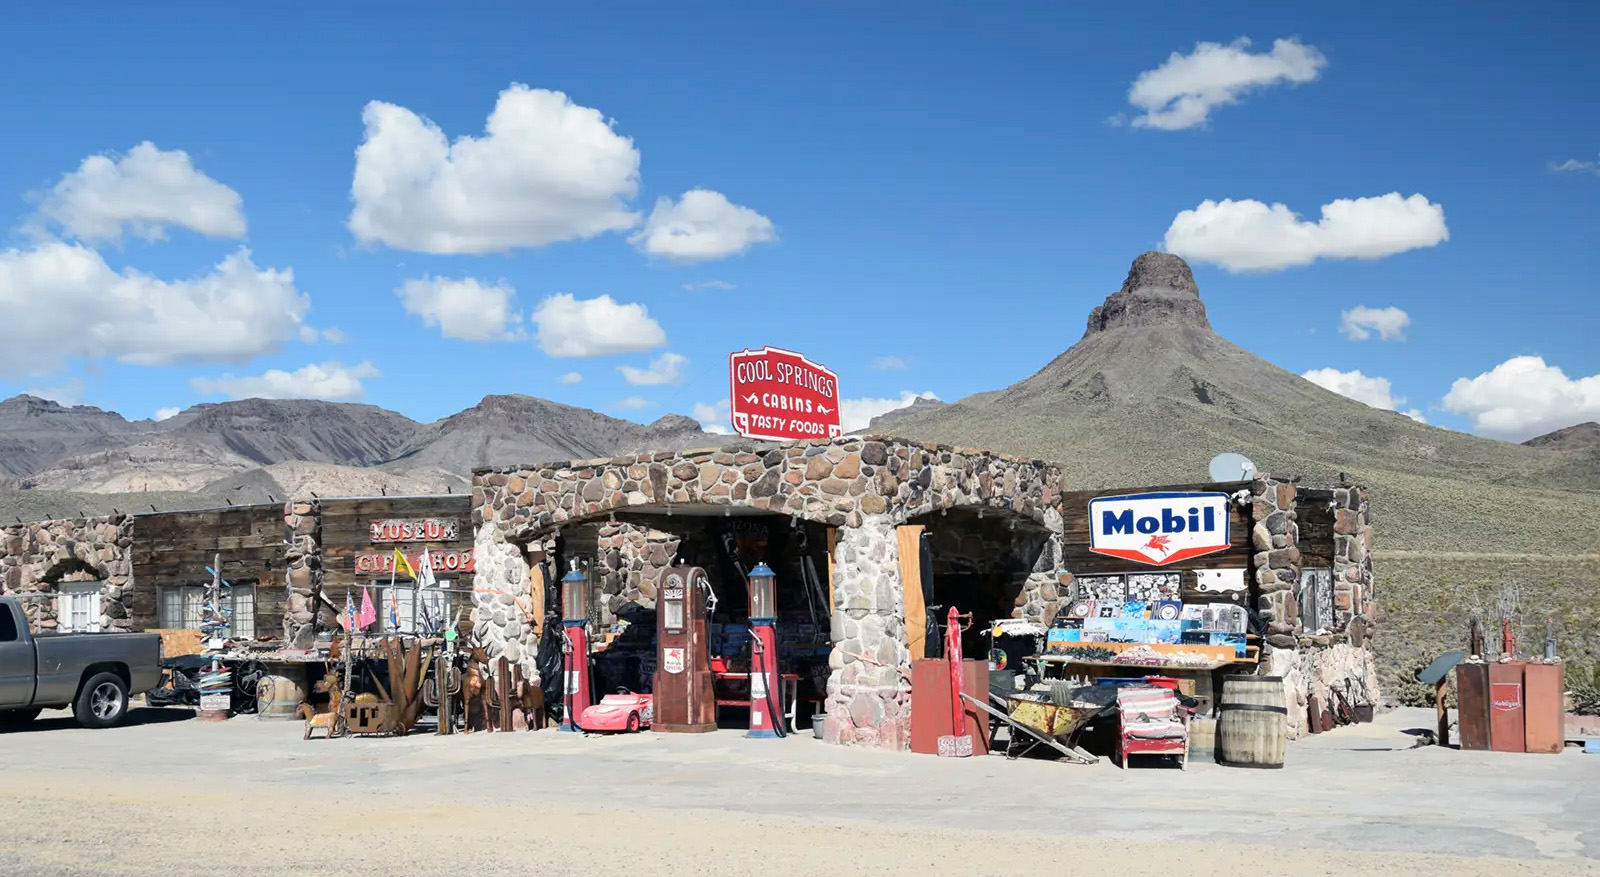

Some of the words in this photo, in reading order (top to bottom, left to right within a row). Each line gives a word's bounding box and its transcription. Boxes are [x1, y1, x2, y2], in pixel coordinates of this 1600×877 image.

[736, 359, 773, 384] COOL
[776, 361, 834, 398] SPRINGS
[762, 392, 813, 413] CABINS
[751, 413, 786, 431] TASTY
[789, 419, 825, 435] FOODS
[371, 521, 456, 540] MUSEUM
[1102, 506, 1215, 536] Mobil
[358, 553, 406, 571] GIF
[418, 552, 471, 571] HOP
